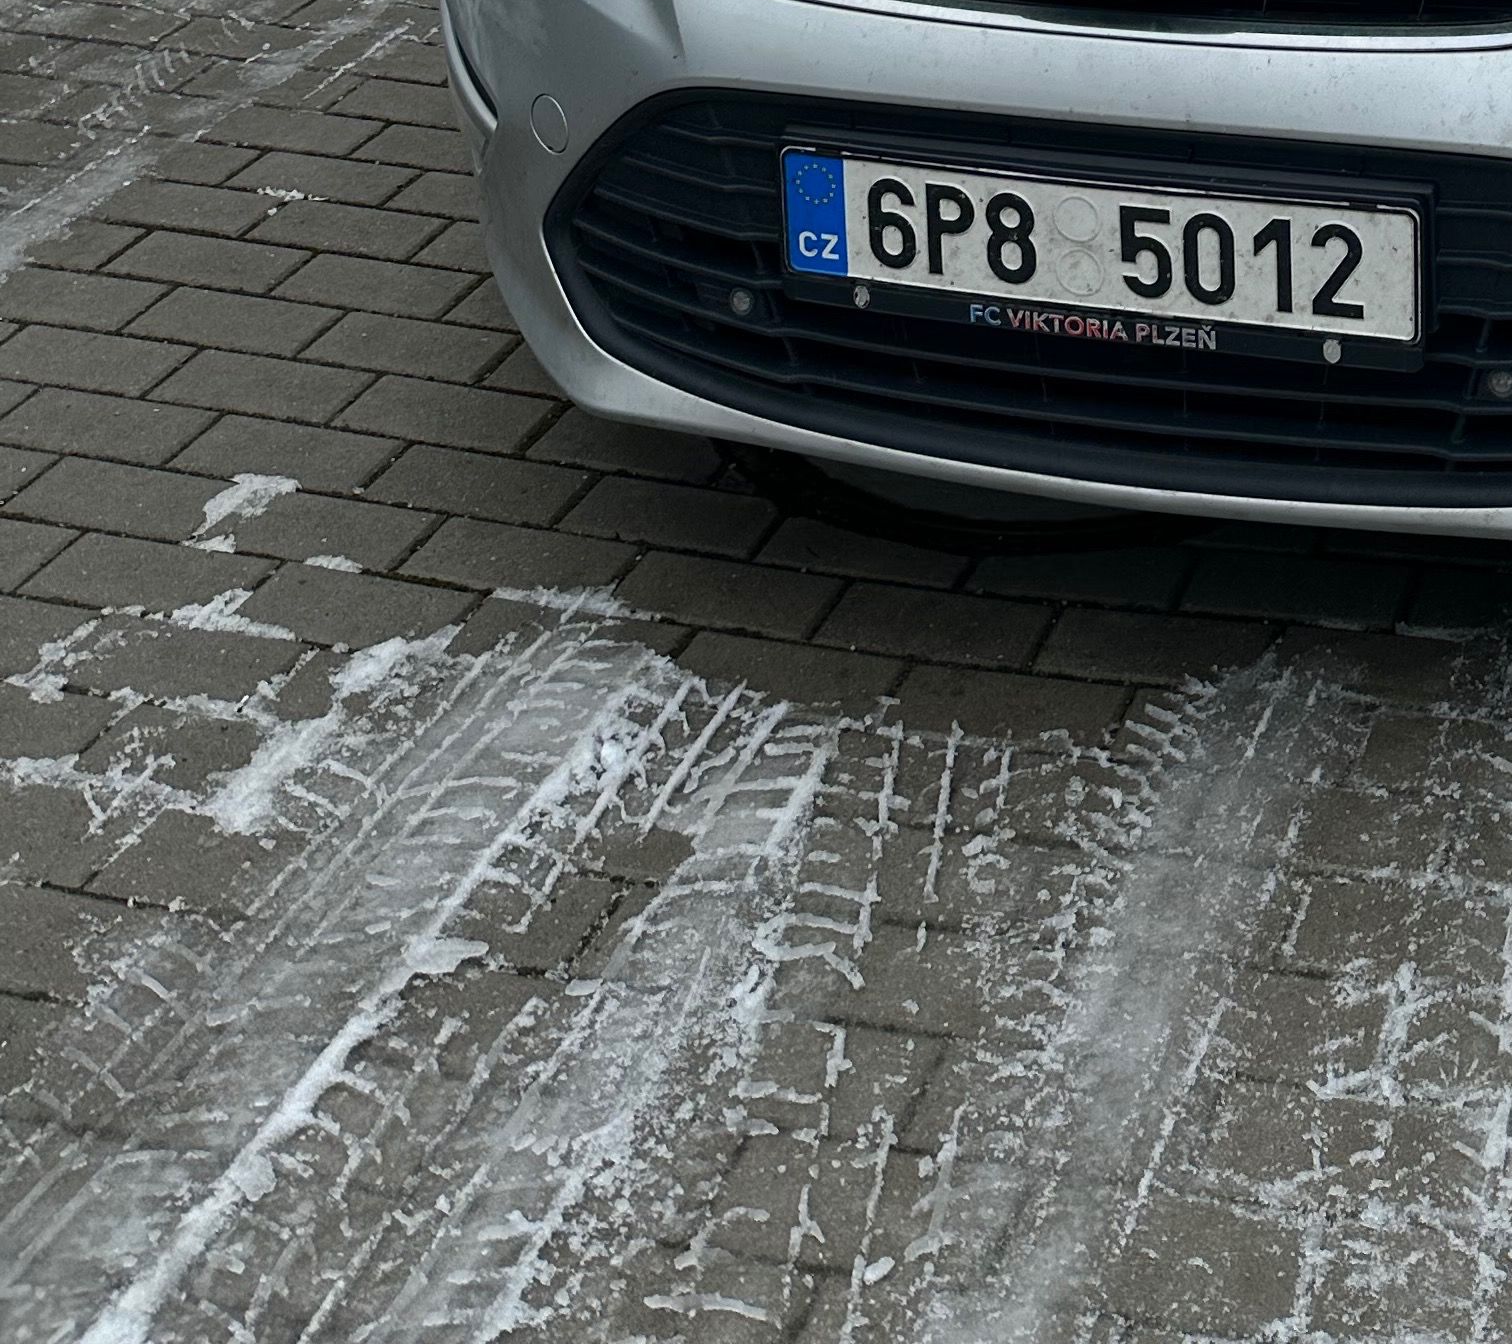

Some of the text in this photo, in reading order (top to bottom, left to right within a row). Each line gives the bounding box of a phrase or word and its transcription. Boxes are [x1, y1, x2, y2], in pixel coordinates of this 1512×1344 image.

[798, 230, 840, 261] CZ
[867, 177, 1365, 320] 6P8 5012
[969, 303, 1217, 351] FC VIKTORIA PLZEŇ
